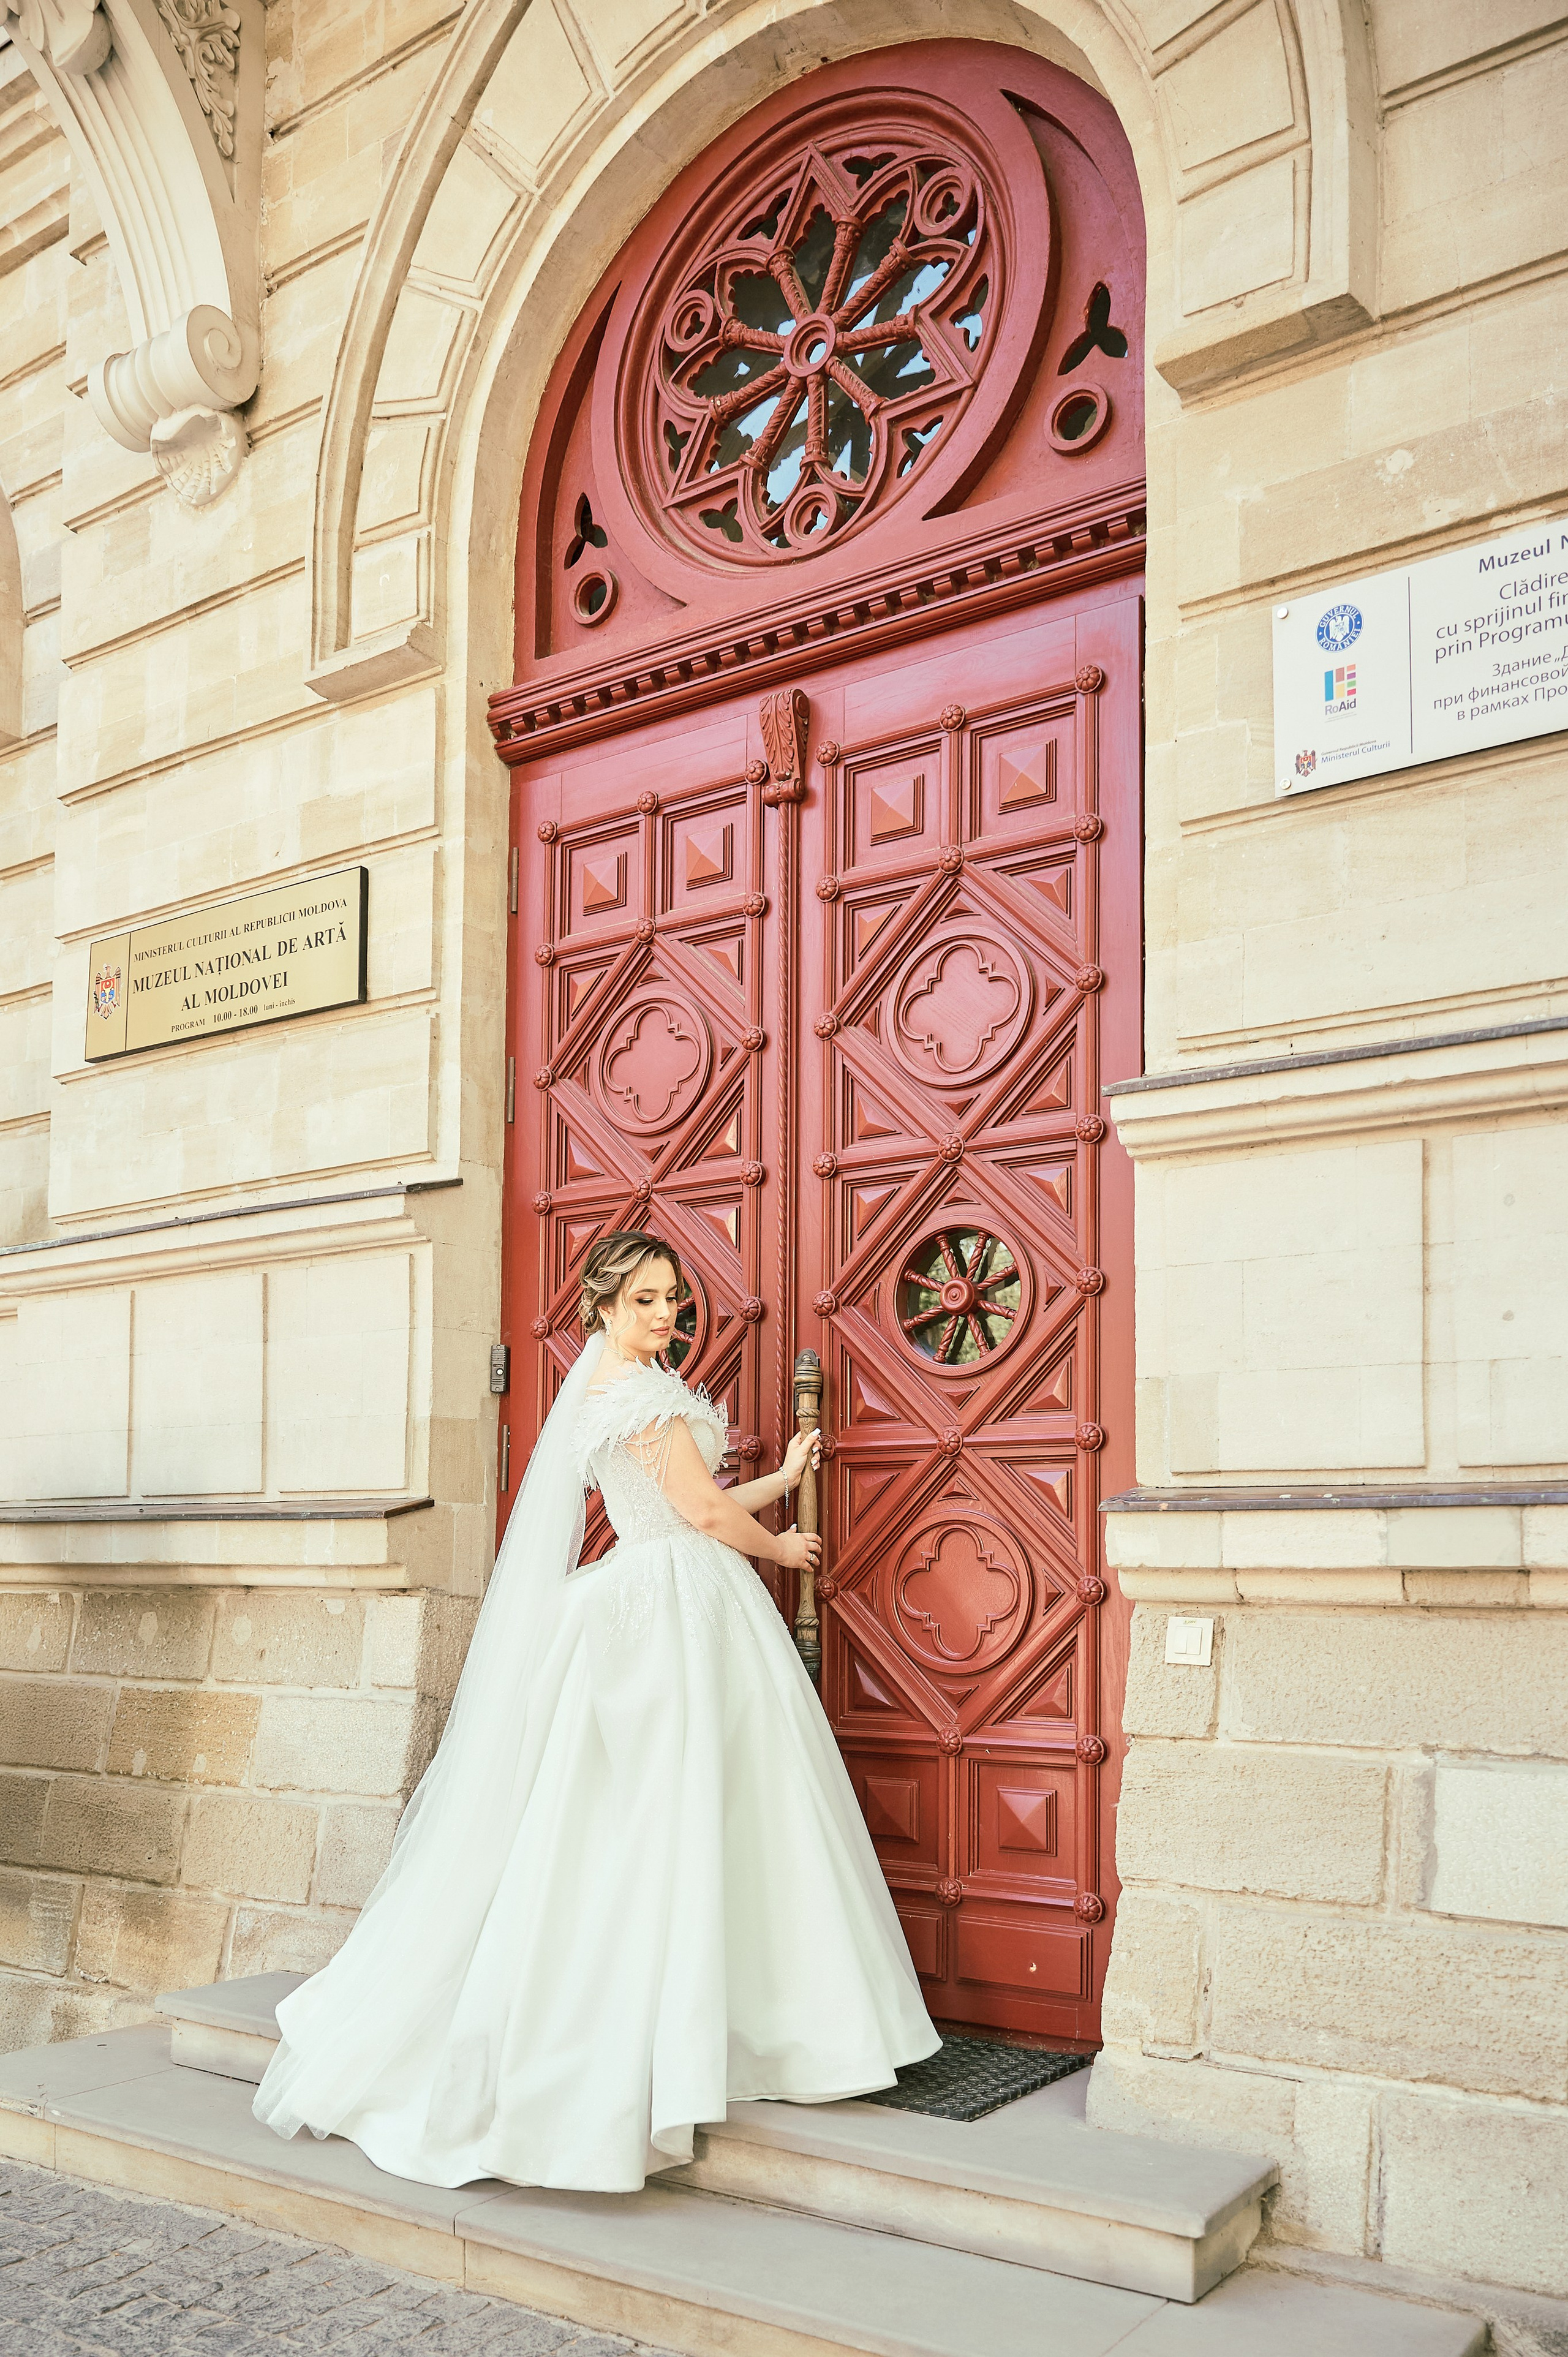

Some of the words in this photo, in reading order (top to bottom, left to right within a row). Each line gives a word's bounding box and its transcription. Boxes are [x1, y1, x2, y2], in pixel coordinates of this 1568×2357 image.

[1479, 538, 1550, 573] Muzeul
[1499, 571, 1568, 600] Clădire
[1319, 605, 1360, 628] GUVERNUL
[1436, 624, 1457, 639] cu
[1464, 596, 1542, 633] sprijinul
[1436, 639, 1472, 664] prin
[1492, 653, 1551, 677] Здание
[1434, 694, 1463, 710] при
[1468, 663, 1568, 703] финансовой
[1457, 711, 1465, 720] в
[1471, 694, 1529, 720] рамках
[1534, 685, 1567, 701] Про
[1325, 698, 1356, 715] RoAid
[1321, 749, 1360, 763] Ministerul
[1362, 741, 1390, 753] Culturii
[134, 941, 184, 962] MINISTERUL
[186, 929, 227, 948] CULTURII
[229, 926, 241, 937] AL
[244, 911, 295, 933] REPUBLICII
[298, 898, 347, 919] MOLDOVA
[133, 966, 192, 994] MUZEUL
[195, 945, 272, 978] NAȚIONAL
[277, 937, 298, 957] DE
[303, 921, 347, 951] ARTĂ
[181, 994, 200, 1011] AL
[205, 971, 288, 1006] MOLDOVEI
[171, 1018, 205, 1033] PROGRAM
[213, 1011, 232, 1023] 10.00
[239, 1005, 258, 1017] 18.00
[263, 1002, 274, 1011] luni
